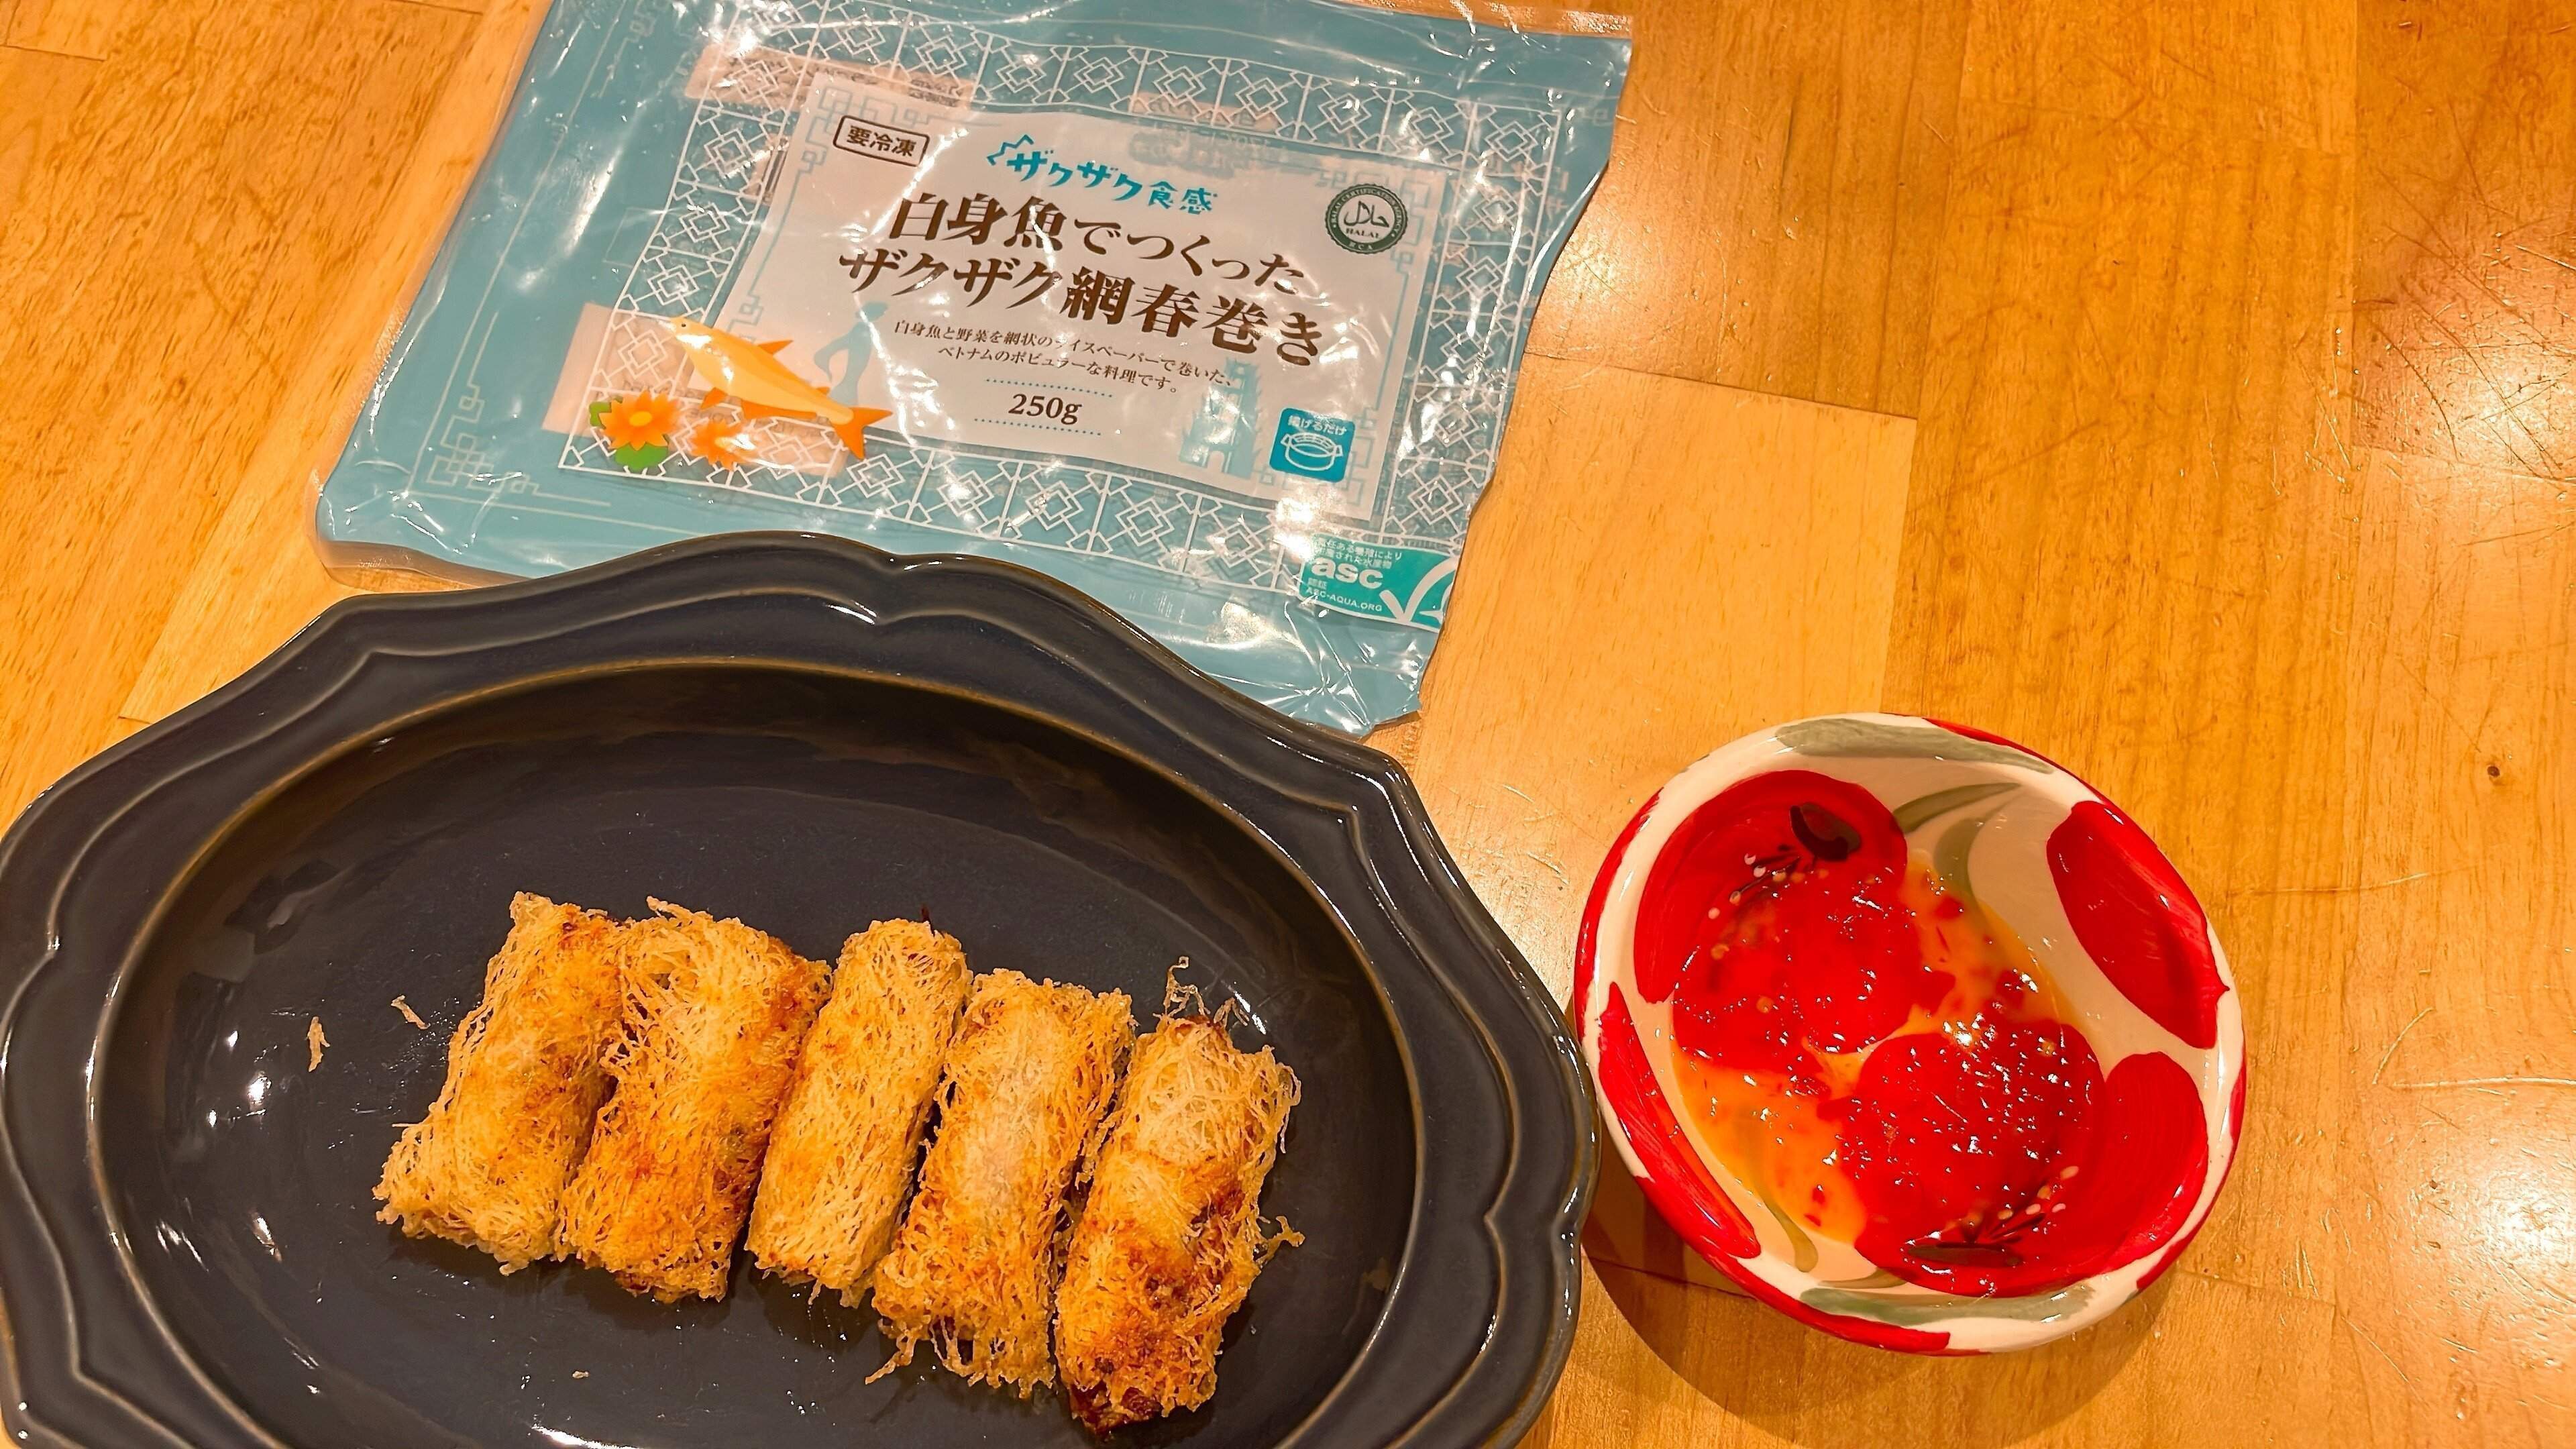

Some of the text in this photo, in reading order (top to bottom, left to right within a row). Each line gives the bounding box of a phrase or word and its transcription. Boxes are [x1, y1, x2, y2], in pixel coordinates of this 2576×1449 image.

[847, 125, 916, 157] 要冷凍
[1006, 150, 1218, 215] ザクザク食感
[889, 193, 1303, 295] 白身魚でつくった
[1346, 227, 1379, 239] HALAL
[839, 247, 1323, 367] ザクザク網春巻き
[1008, 393, 1082, 425] 250g
[1311, 557, 1383, 589] asc
[1306, 587, 1382, 612] ASC-AQUA.ORG
